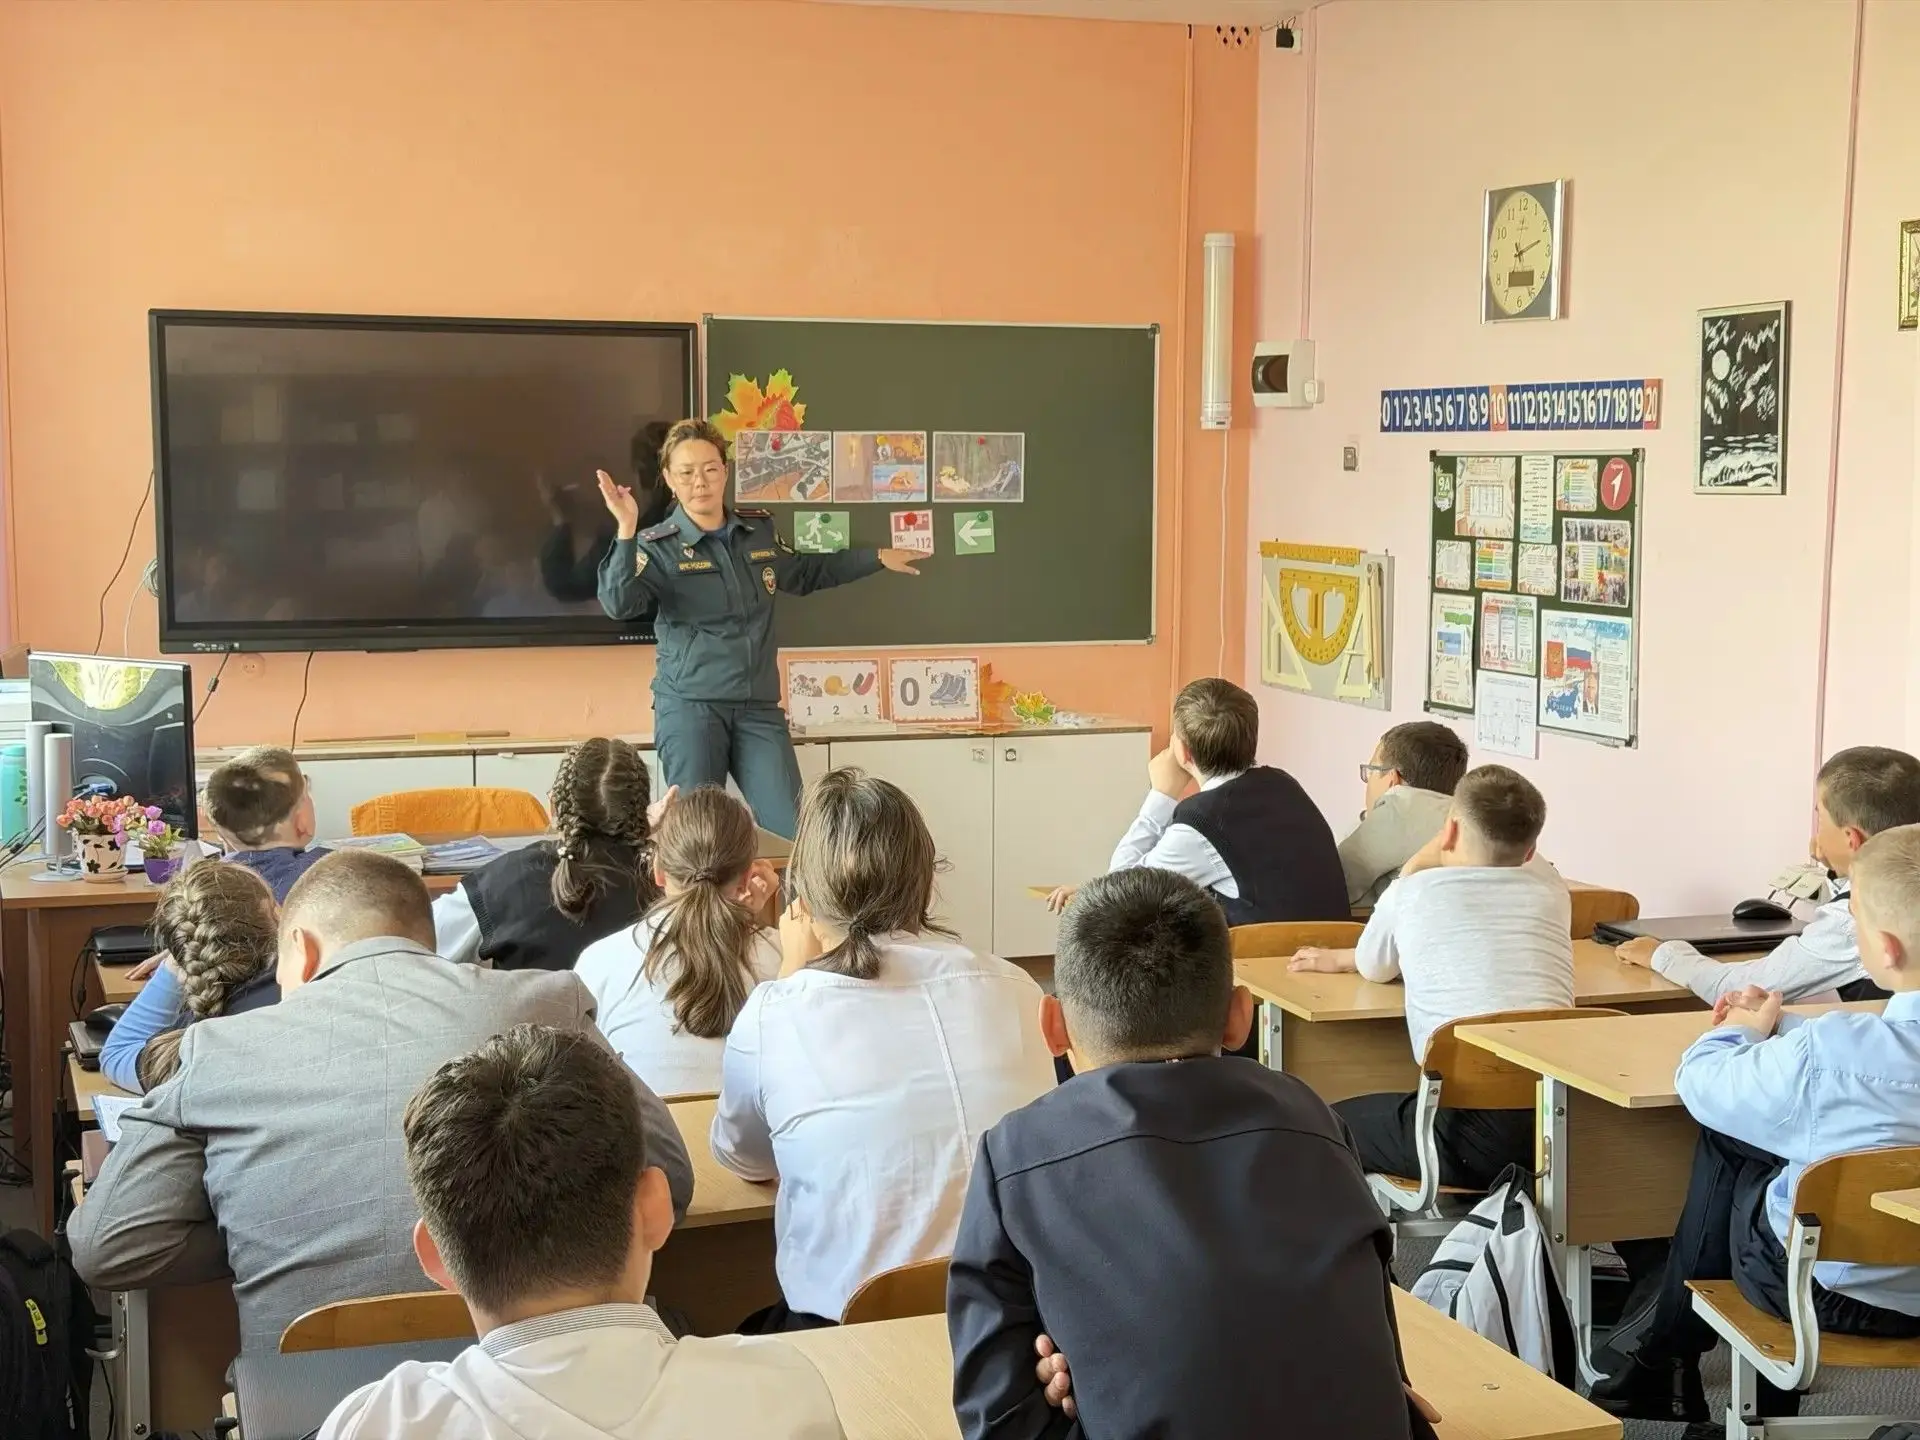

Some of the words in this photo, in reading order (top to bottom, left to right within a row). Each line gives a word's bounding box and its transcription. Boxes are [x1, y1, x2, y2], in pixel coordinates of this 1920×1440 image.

[1519, 198, 1529, 211] 12
[1507, 208, 1515, 221] 11
[1542, 220, 1548, 232] 2
[1497, 227, 1507, 240] 10
[1492, 250, 1499, 263] 9
[1545, 245, 1550, 257] 3
[1496, 274, 1501, 285] 8
[1540, 271, 1546, 280] 4
[1503, 290, 1510, 303] 7
[1530, 288, 1536, 297] 5
[1516, 296, 1522, 308] 6
[1382, 396, 1390, 427] 0
[1394, 397, 1399, 426] 1
[1403, 396, 1411, 426] 2
[1413, 396, 1421, 426] 3
[1424, 396, 1432, 425] 4
[1435, 395, 1442, 426] 5
[1446, 394, 1454, 425] 6
[1457, 394, 1465, 425] 7
[1469, 393, 1478, 425] 8
[1480, 392, 1488, 425] 9
[1491, 392, 1505, 425] 10
[1508, 392, 1520, 424] 11
[1522, 391, 1536, 424] 12
[1537, 390, 1550, 424] 13
[1552, 390, 1565, 423] 14
[1567, 390, 1580, 423] 15
[1581, 389, 1596, 423] 16
[1597, 388, 1610, 422] 17
[1613, 388, 1627, 422] 18
[1629, 387, 1643, 422] 19
[1645, 387, 1658, 422] 20
[1610, 469, 1624, 507] 1
[916, 537, 931, 549] 112
[925, 666, 931, 677] Г
[806, 706, 812, 716] 1
[832, 705, 839, 715] 2
[863, 705, 869, 714] 1
